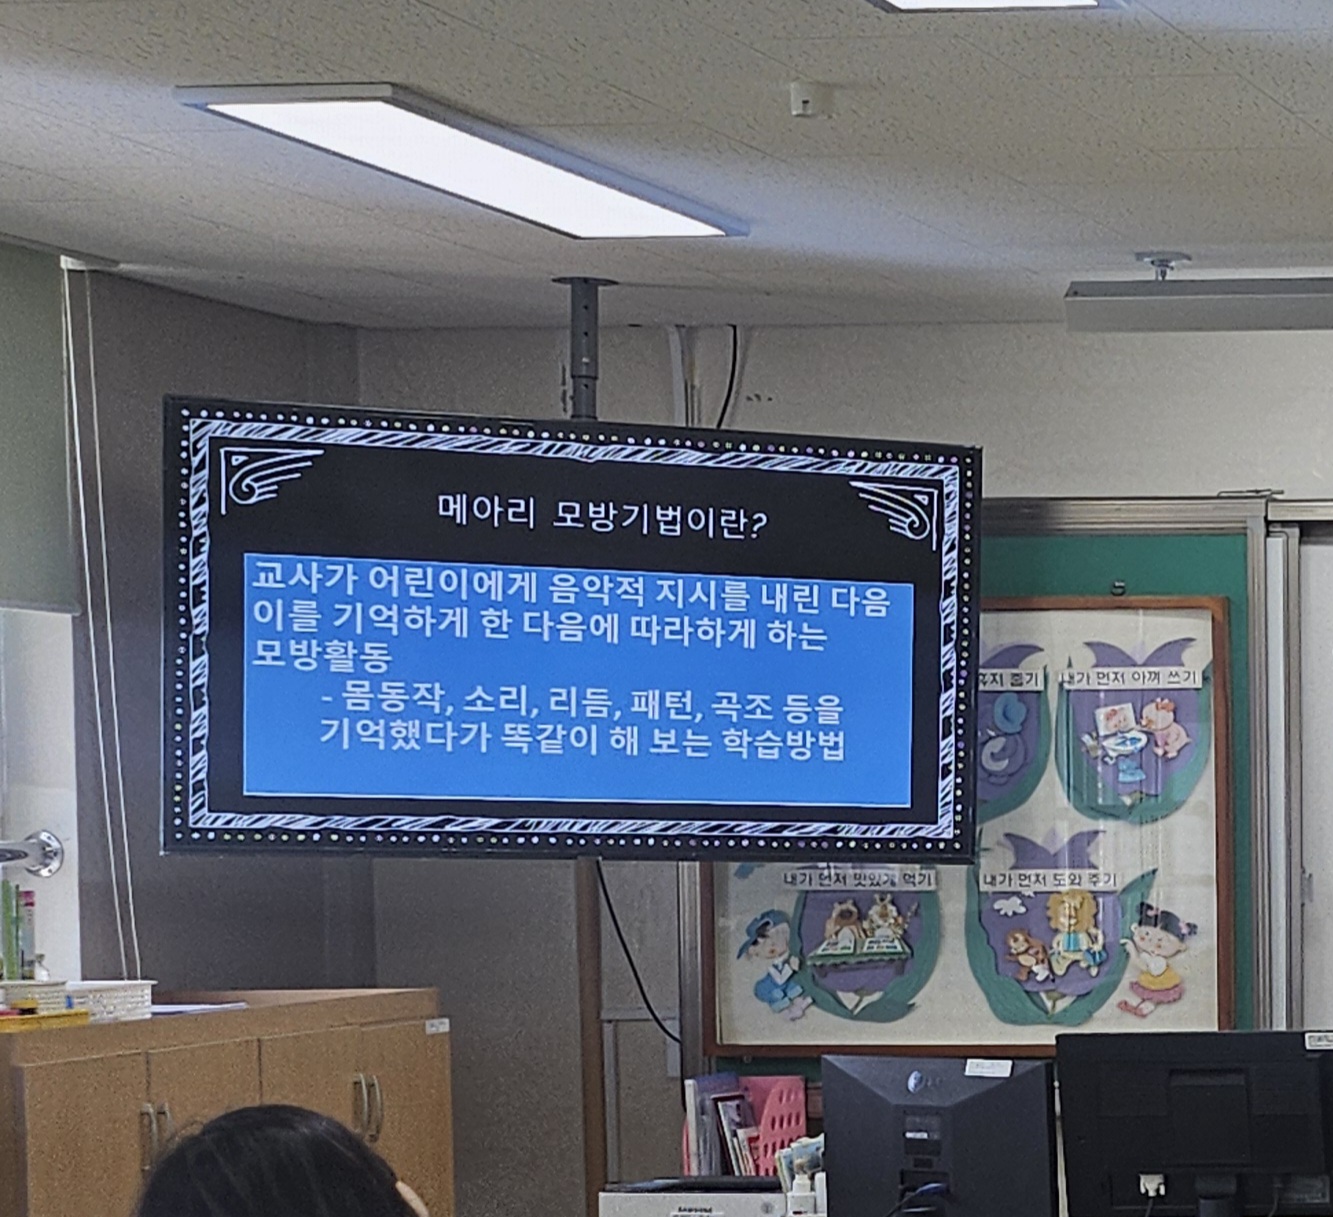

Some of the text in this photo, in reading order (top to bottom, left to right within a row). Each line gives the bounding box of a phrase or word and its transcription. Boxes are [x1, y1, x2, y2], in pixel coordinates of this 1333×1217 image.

[439, 494, 766, 538] 메아리 모방기법이란?
[253, 562, 890, 616] 교사가 어린이에게 음악적 지시를 내린 다음
[255, 600, 826, 650] 이를 기억하게 한 다음에 따라하게 하는
[253, 640, 391, 672] 모방활동
[1061, 672, 1091, 686] 내가
[1096, 672, 1125, 686] 먼저
[1167, 671, 1196, 685] 쓰기
[343, 681, 452, 715] 몸동작,
[465, 686, 537, 717] 소리,
[551, 687, 620, 719] 리듬,
[632, 690, 701, 722] 패턴,
[712, 692, 772, 721] 곡조
[783, 695, 842, 724] 등을
[322, 719, 843, 760] 기억했다가 똑같이 해 보는 학습방법
[784, 871, 813, 887] 내가
[902, 871, 932, 887] 먹기
[984, 872, 1117, 888] 내가 먼저 도와 주기
